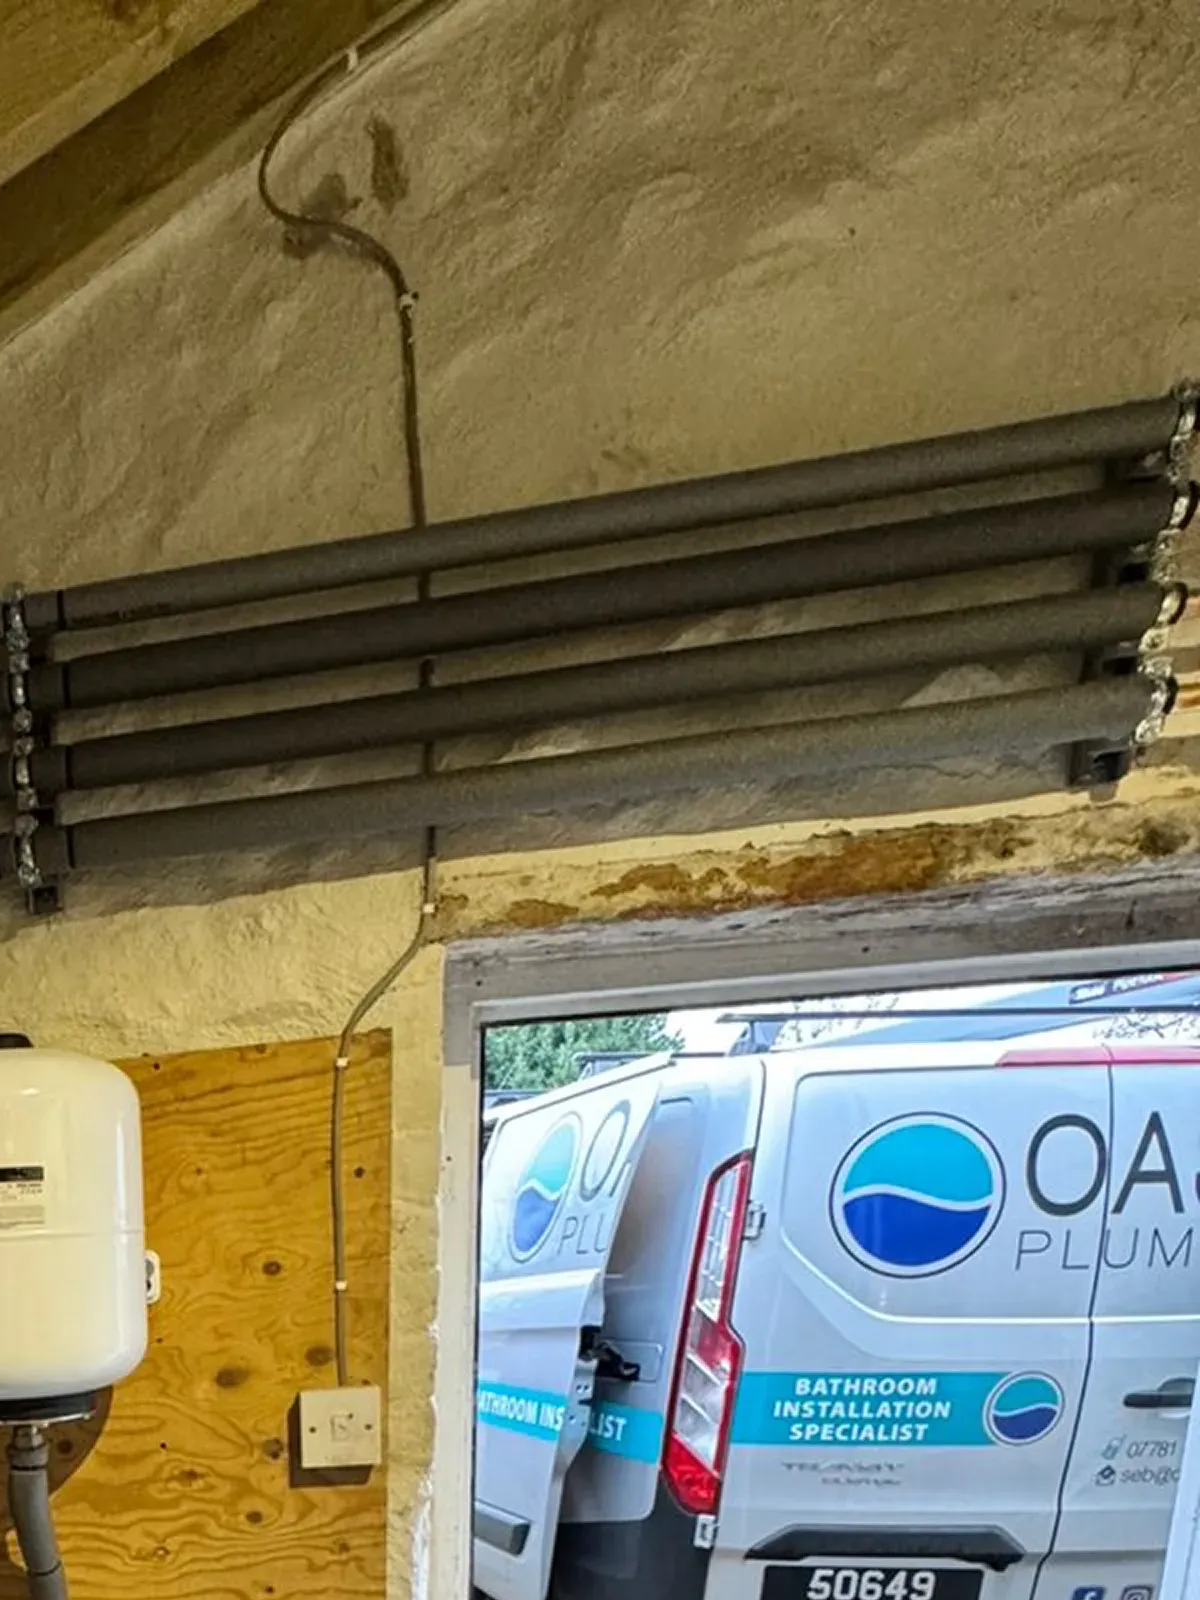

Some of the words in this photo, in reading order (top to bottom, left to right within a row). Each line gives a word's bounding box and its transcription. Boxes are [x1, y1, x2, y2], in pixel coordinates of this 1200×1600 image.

[1026, 1110, 1200, 1217] OA
[1015, 1226, 1194, 1271] PLUM
[794, 1377, 938, 1396] BATHROOM
[477, 1390, 538, 1425] ATHROOM
[772, 1400, 951, 1418] INSTALLATION
[788, 1423, 929, 1441] SPECIALIST
